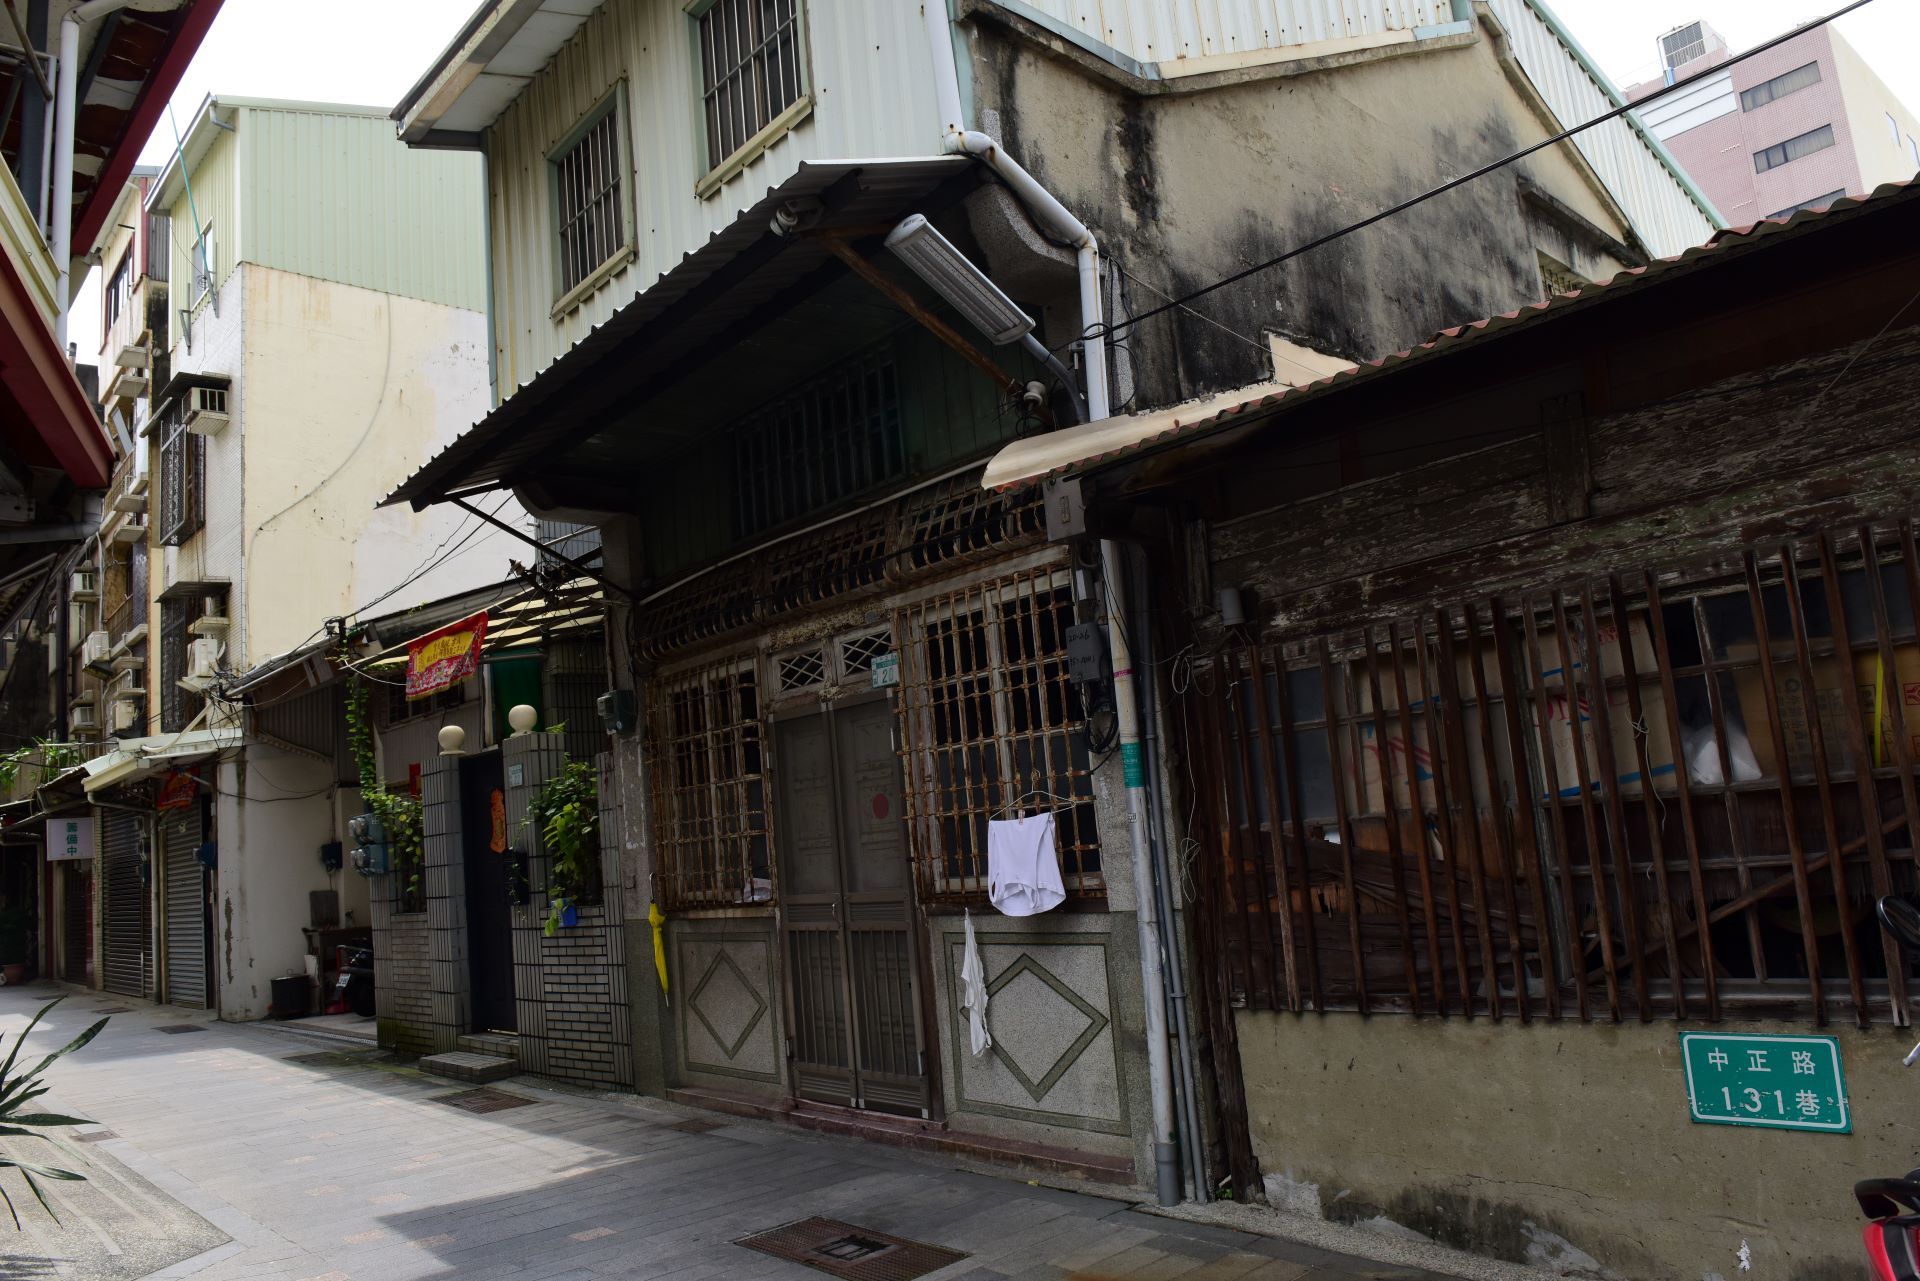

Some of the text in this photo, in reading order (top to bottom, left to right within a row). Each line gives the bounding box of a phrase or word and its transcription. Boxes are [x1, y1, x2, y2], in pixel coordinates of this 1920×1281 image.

[1708, 1047, 1816, 1075] 中正路
[1722, 1086, 1821, 1116] 131巷
